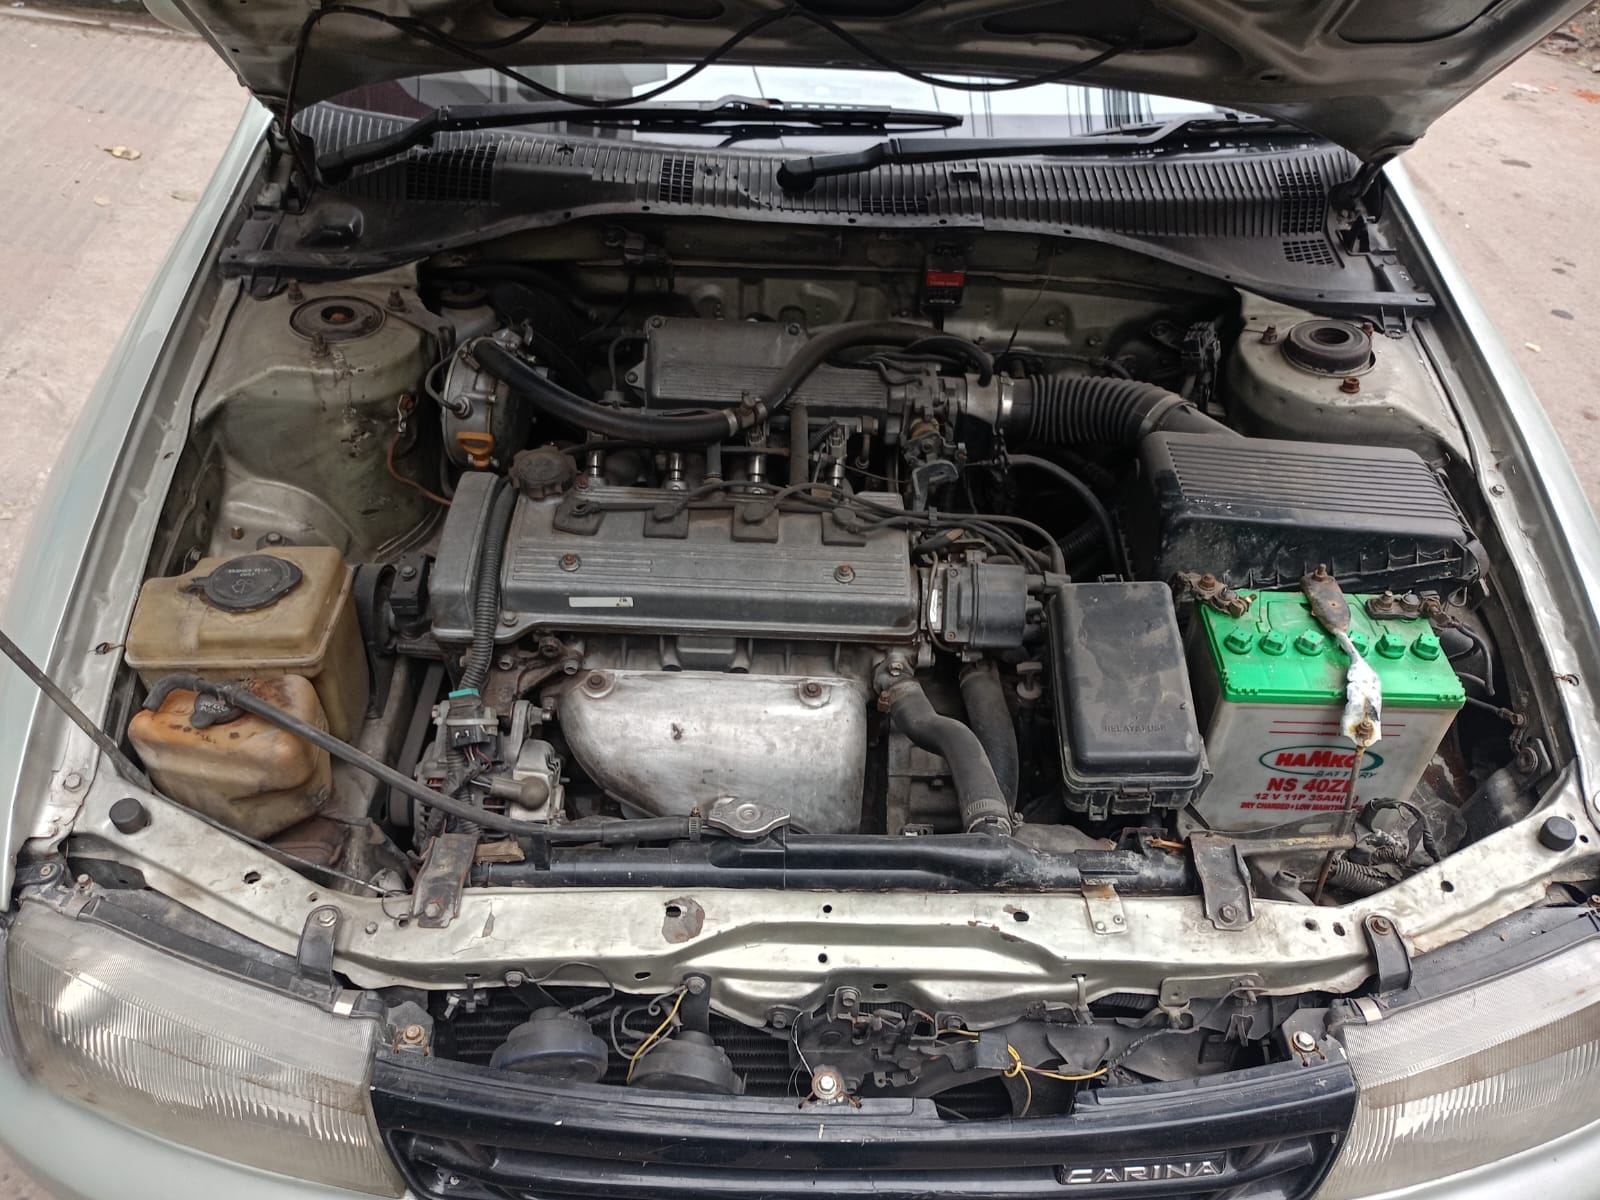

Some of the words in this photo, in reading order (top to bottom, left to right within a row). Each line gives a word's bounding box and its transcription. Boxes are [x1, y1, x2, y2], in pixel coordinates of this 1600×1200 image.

[1314, 770, 1377, 779] BATTRY
[1267, 778, 1298, 791] NS
[1254, 792, 1269, 800] 12
[1067, 1161, 1219, 1183] CARINA
